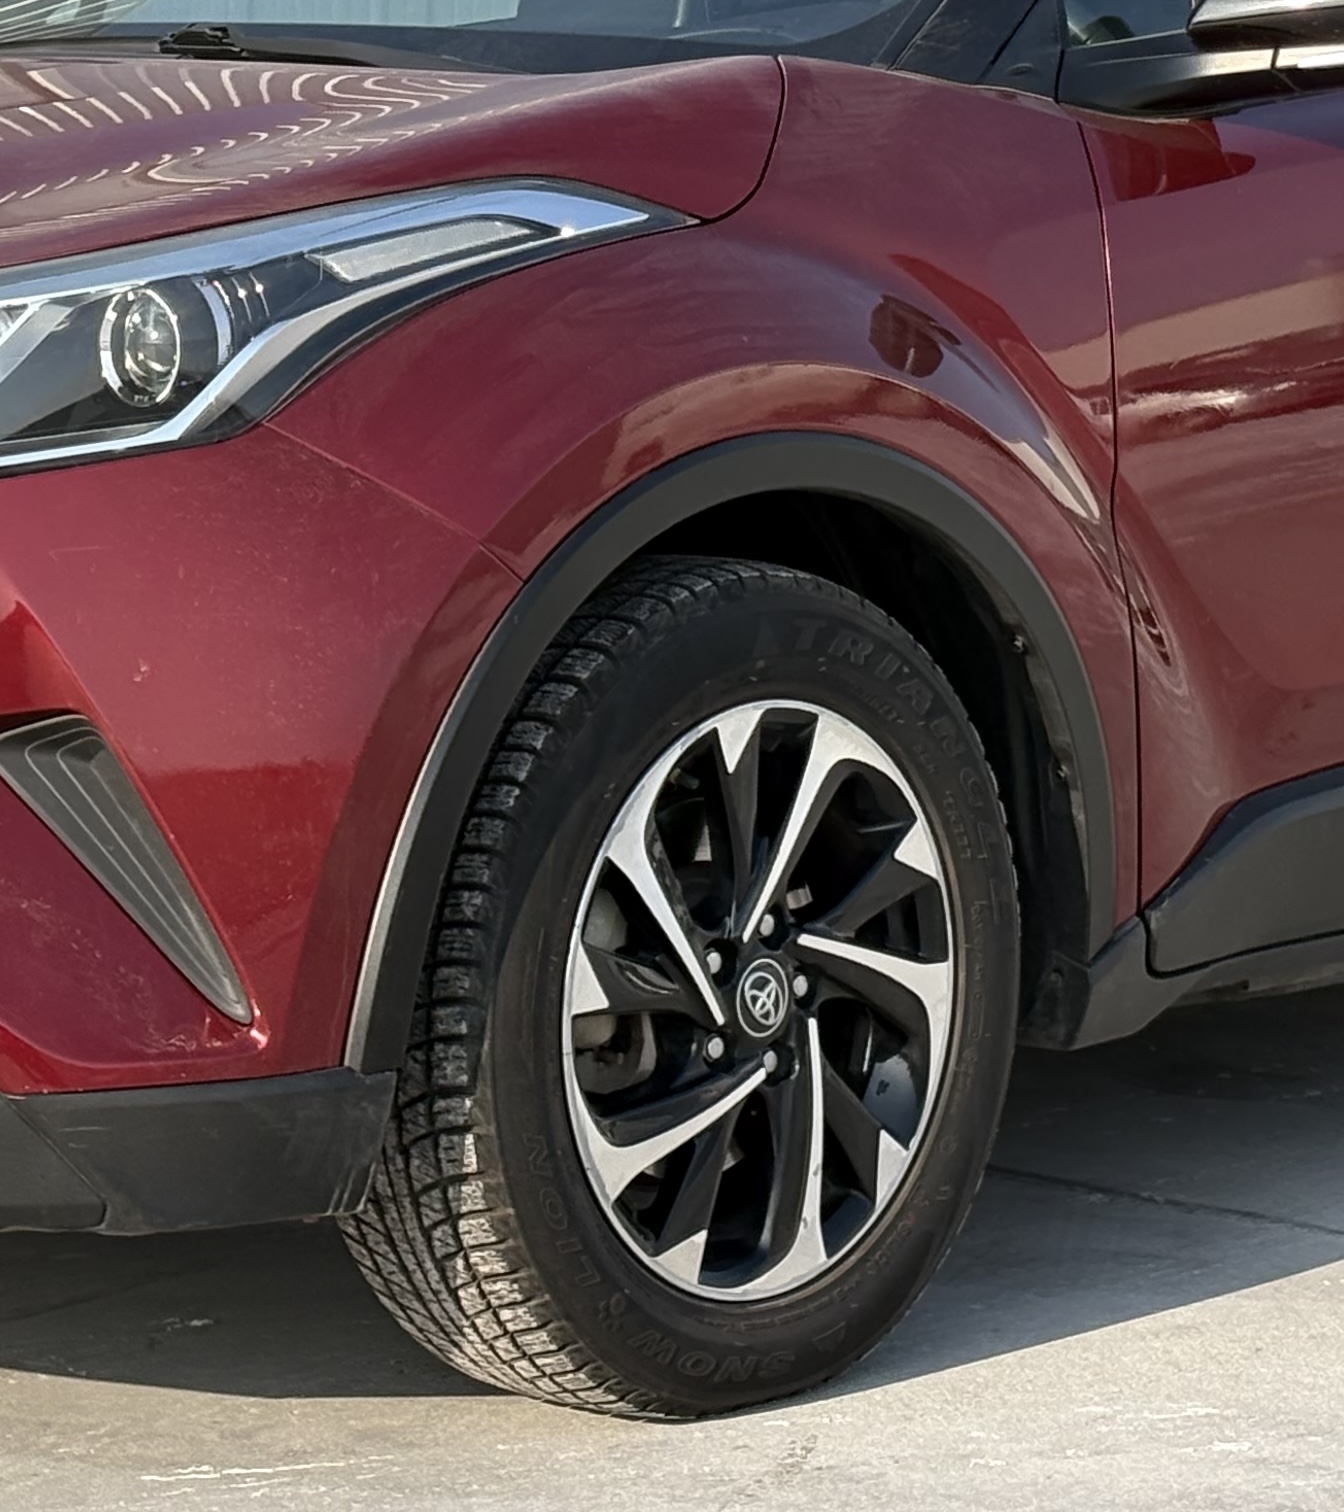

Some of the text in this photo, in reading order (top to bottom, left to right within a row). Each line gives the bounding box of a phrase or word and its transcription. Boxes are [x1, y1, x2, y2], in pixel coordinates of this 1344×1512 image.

[793, 617, 1004, 926] TRIANGLE
[522, 1134, 796, 1383] SNOW LION
